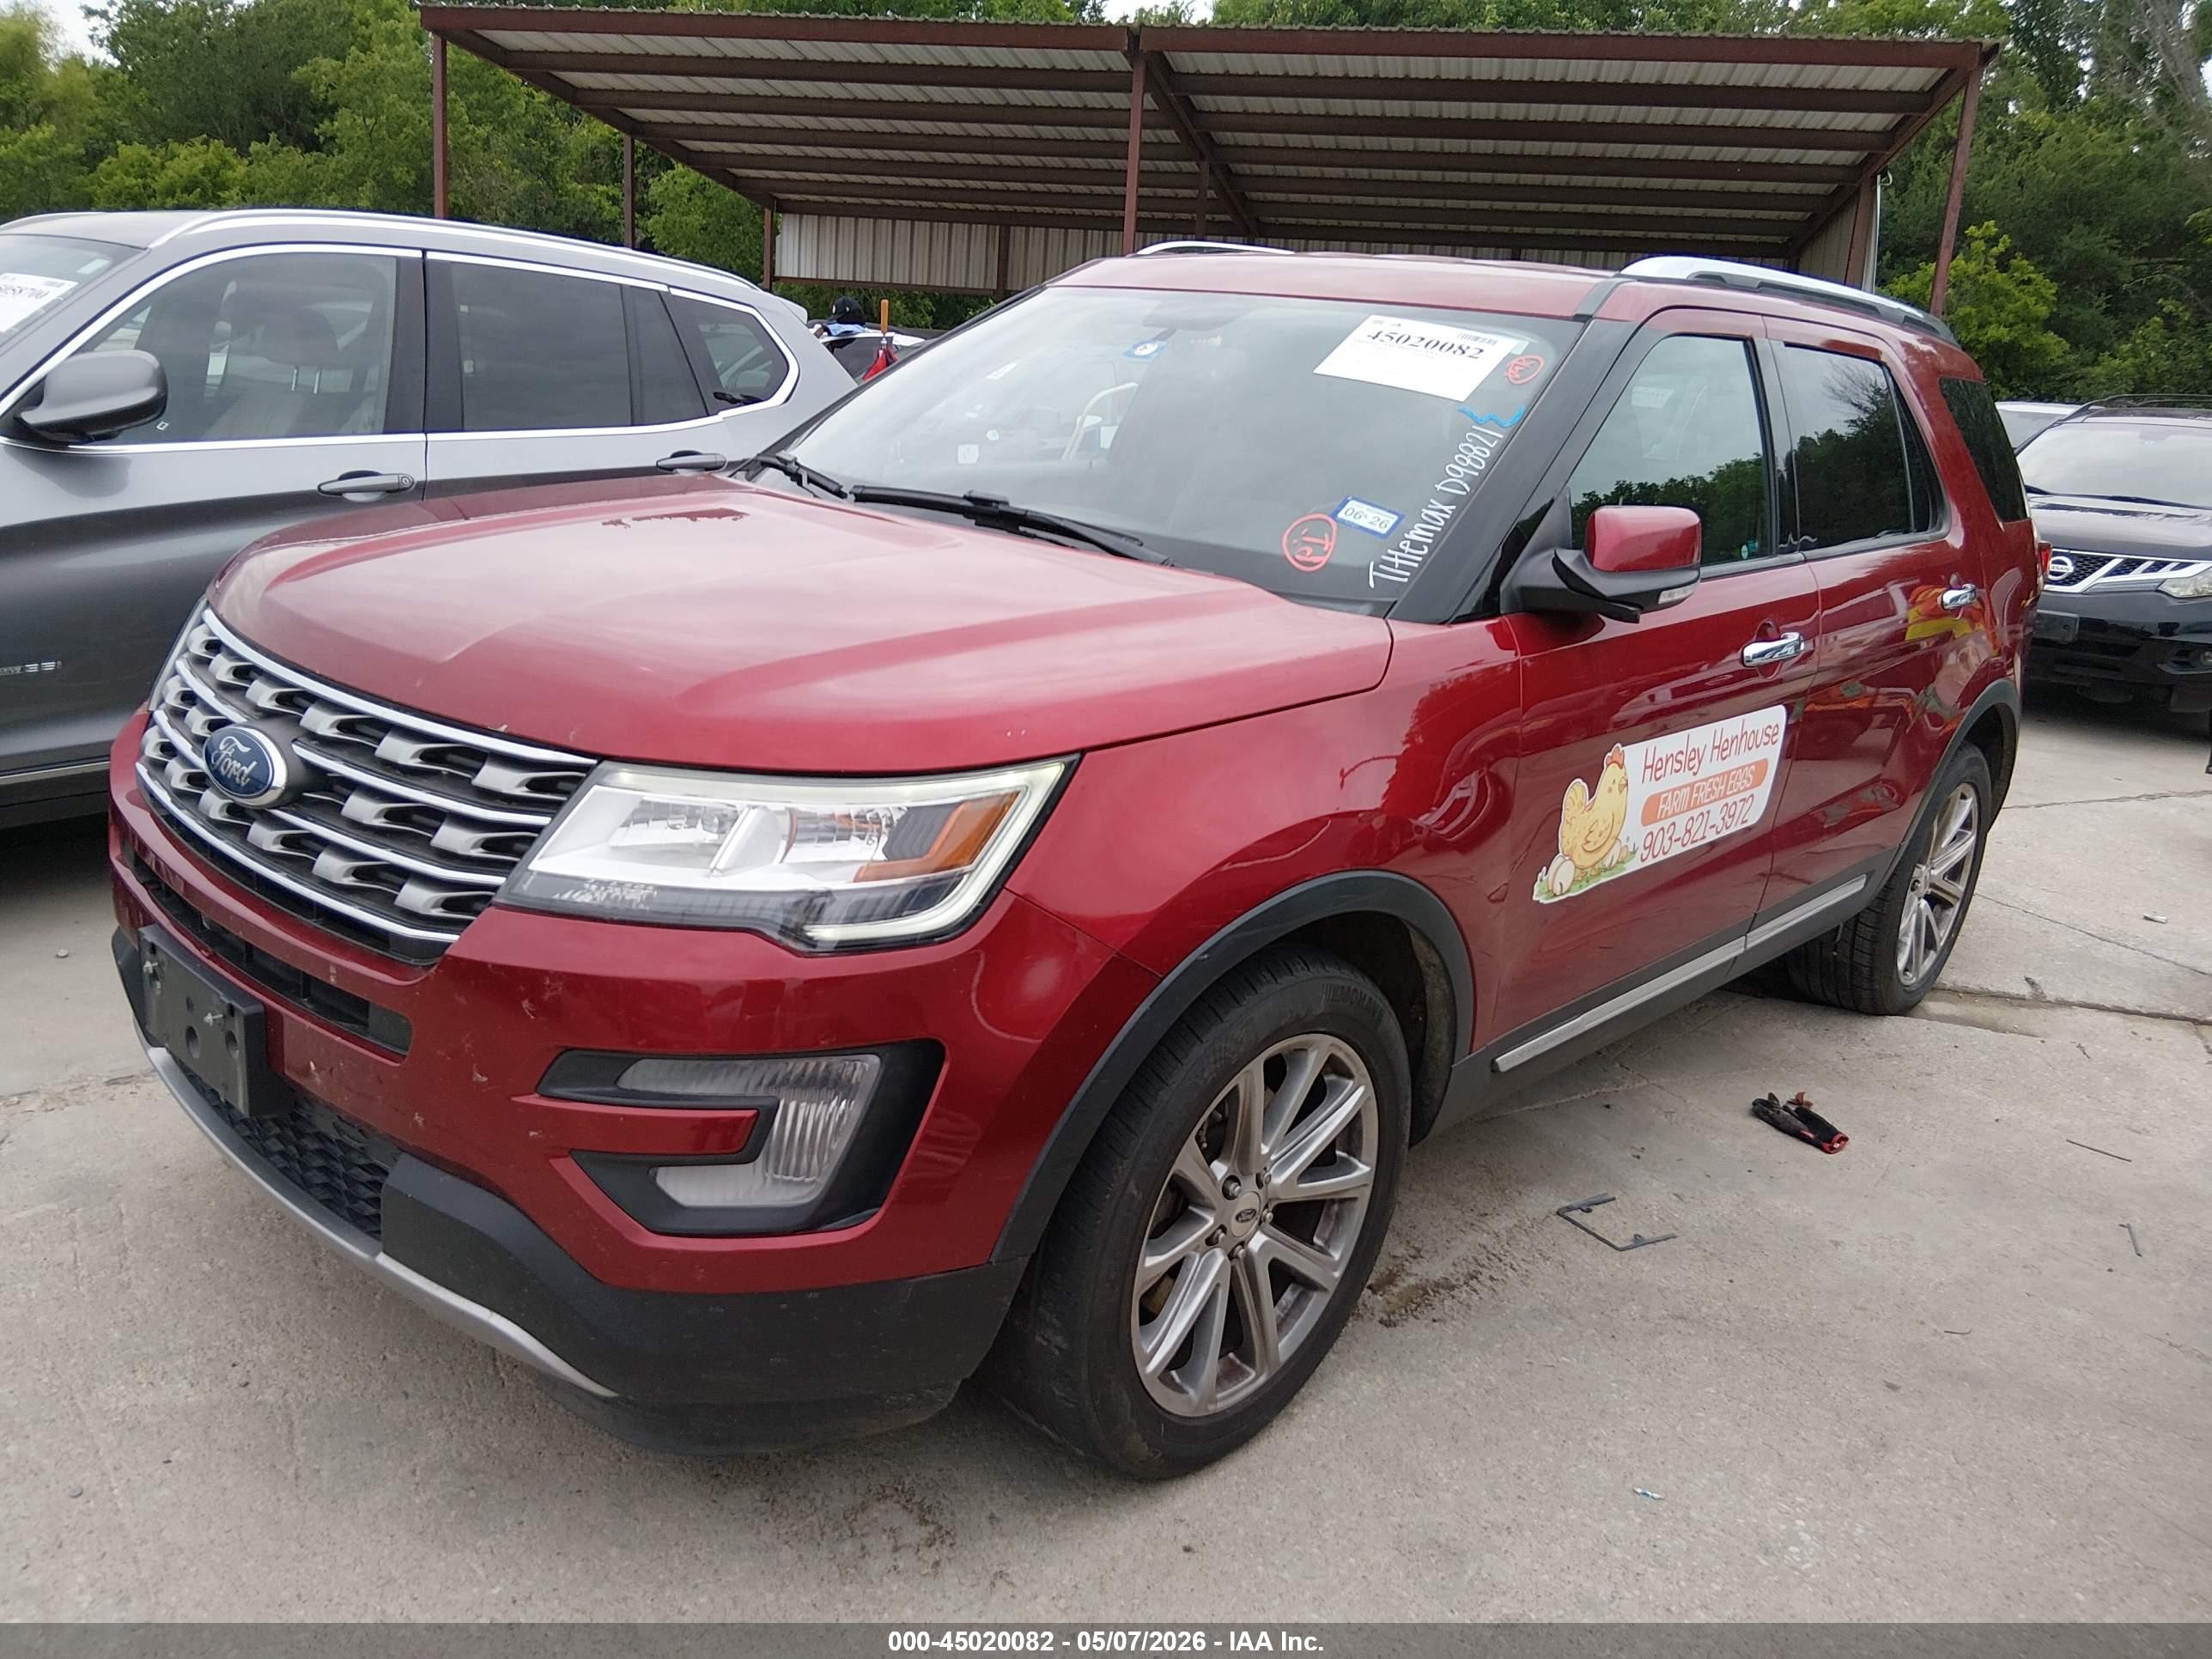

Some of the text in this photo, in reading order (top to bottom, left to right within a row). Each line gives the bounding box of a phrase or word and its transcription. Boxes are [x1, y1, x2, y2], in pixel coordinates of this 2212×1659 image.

[1367, 330, 1485, 360] 45020082
[1435, 425, 1504, 496] D98821
[210, 736, 258, 787] Ford
[1641, 719, 1780, 784] Hensley Henhouse
[1690, 775, 1727, 808] FRESH
[1726, 765, 1756, 795] EGGS
[1640, 793, 1755, 863] 903-821-3972
